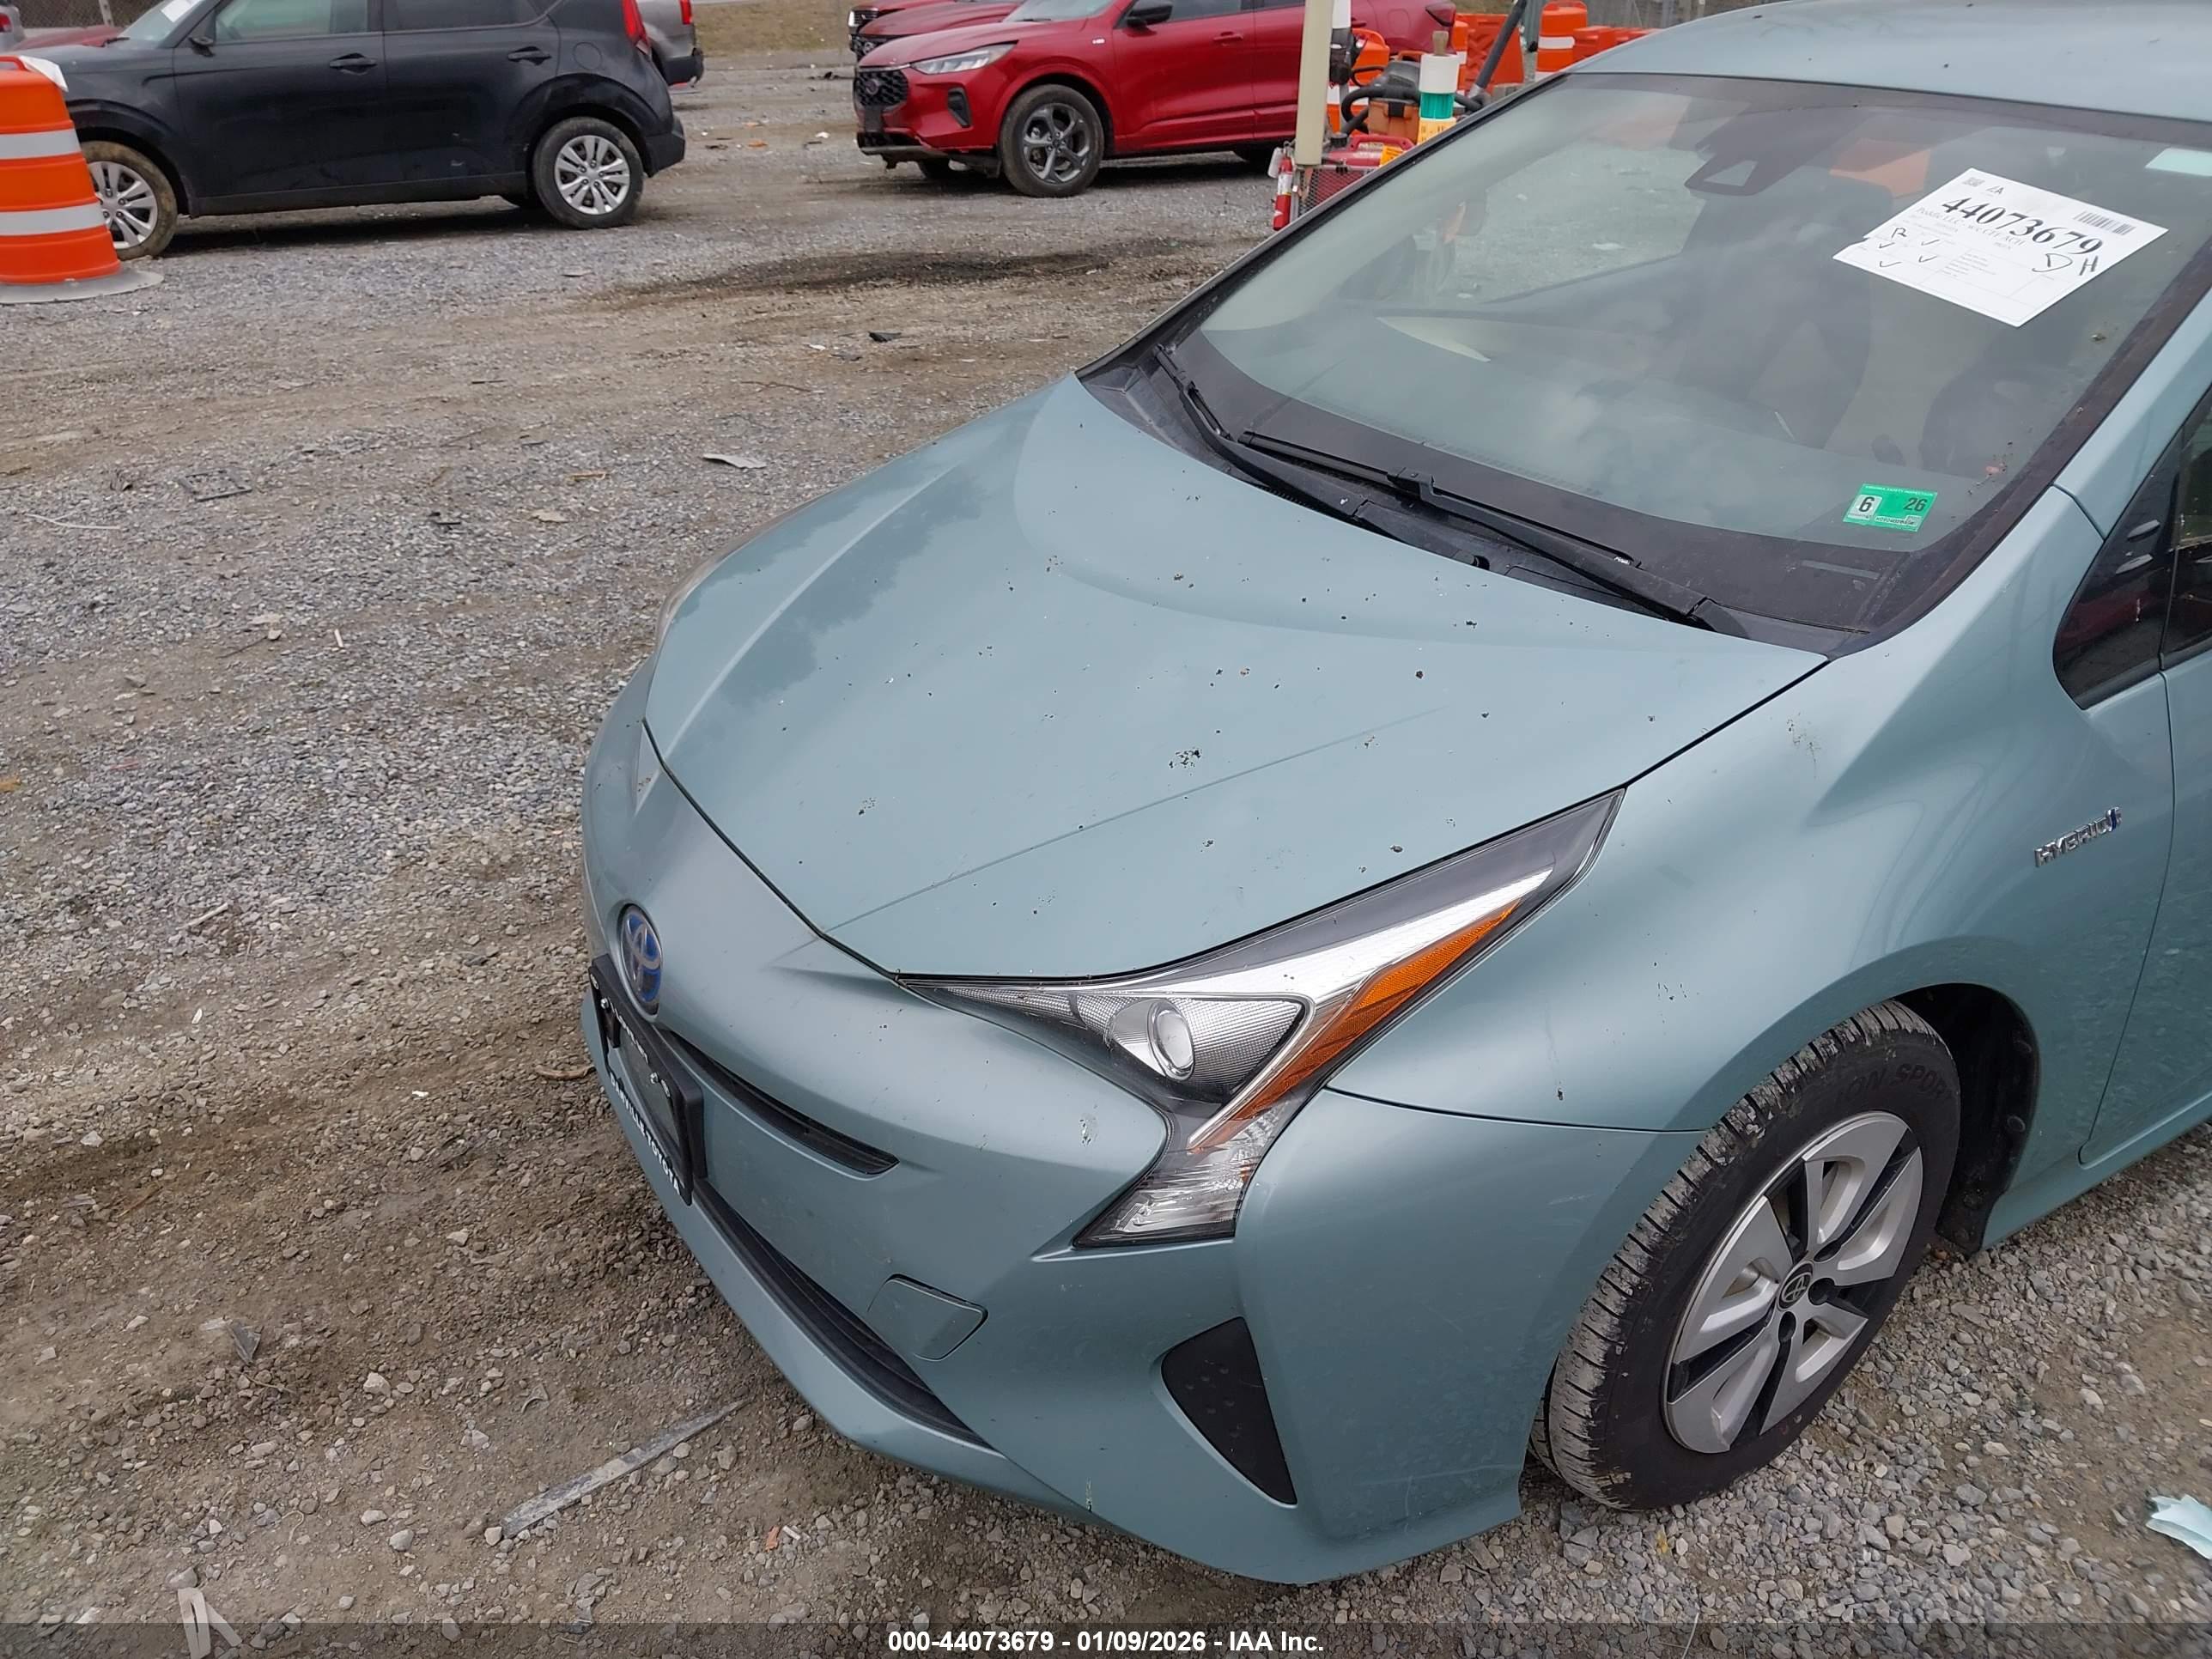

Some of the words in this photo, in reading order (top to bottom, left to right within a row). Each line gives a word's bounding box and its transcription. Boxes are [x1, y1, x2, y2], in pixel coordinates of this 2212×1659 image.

[1941, 198, 2103, 255] 44073679
[1858, 496, 1875, 513] 6
[1903, 498, 1928, 512] 26
[645, 1129, 681, 1196] TOYOTA
